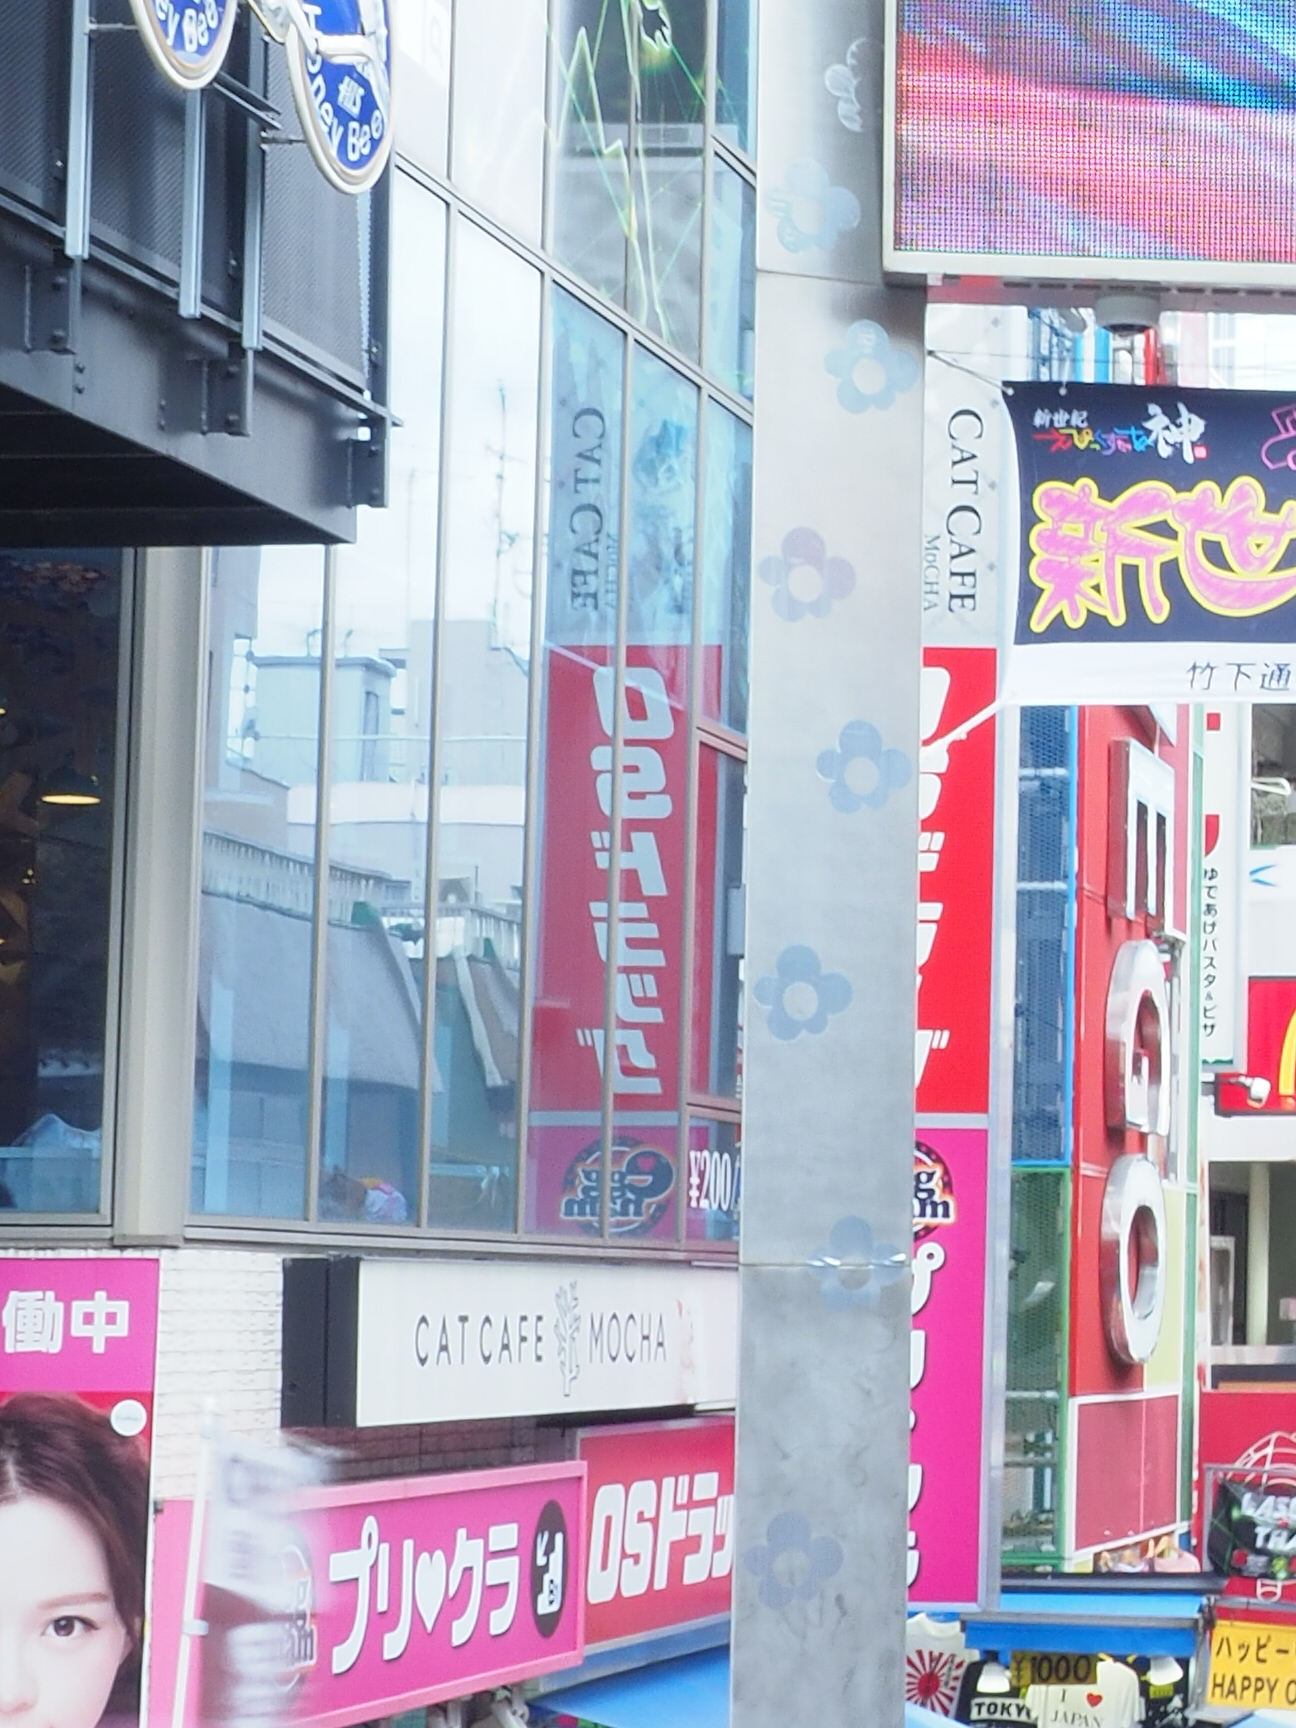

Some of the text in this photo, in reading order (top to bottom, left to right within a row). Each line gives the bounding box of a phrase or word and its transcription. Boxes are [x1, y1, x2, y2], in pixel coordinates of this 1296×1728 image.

[947, 408, 984, 494] CAT
[945, 503, 985, 614] CAFE
[1, 1289, 130, 1355] 働中
[413, 1311, 667, 1368] CAT CAFE MOCHA
[586, 1470, 735, 1606] OSドラッ
[1210, 1671, 1282, 1704] HAPPY
